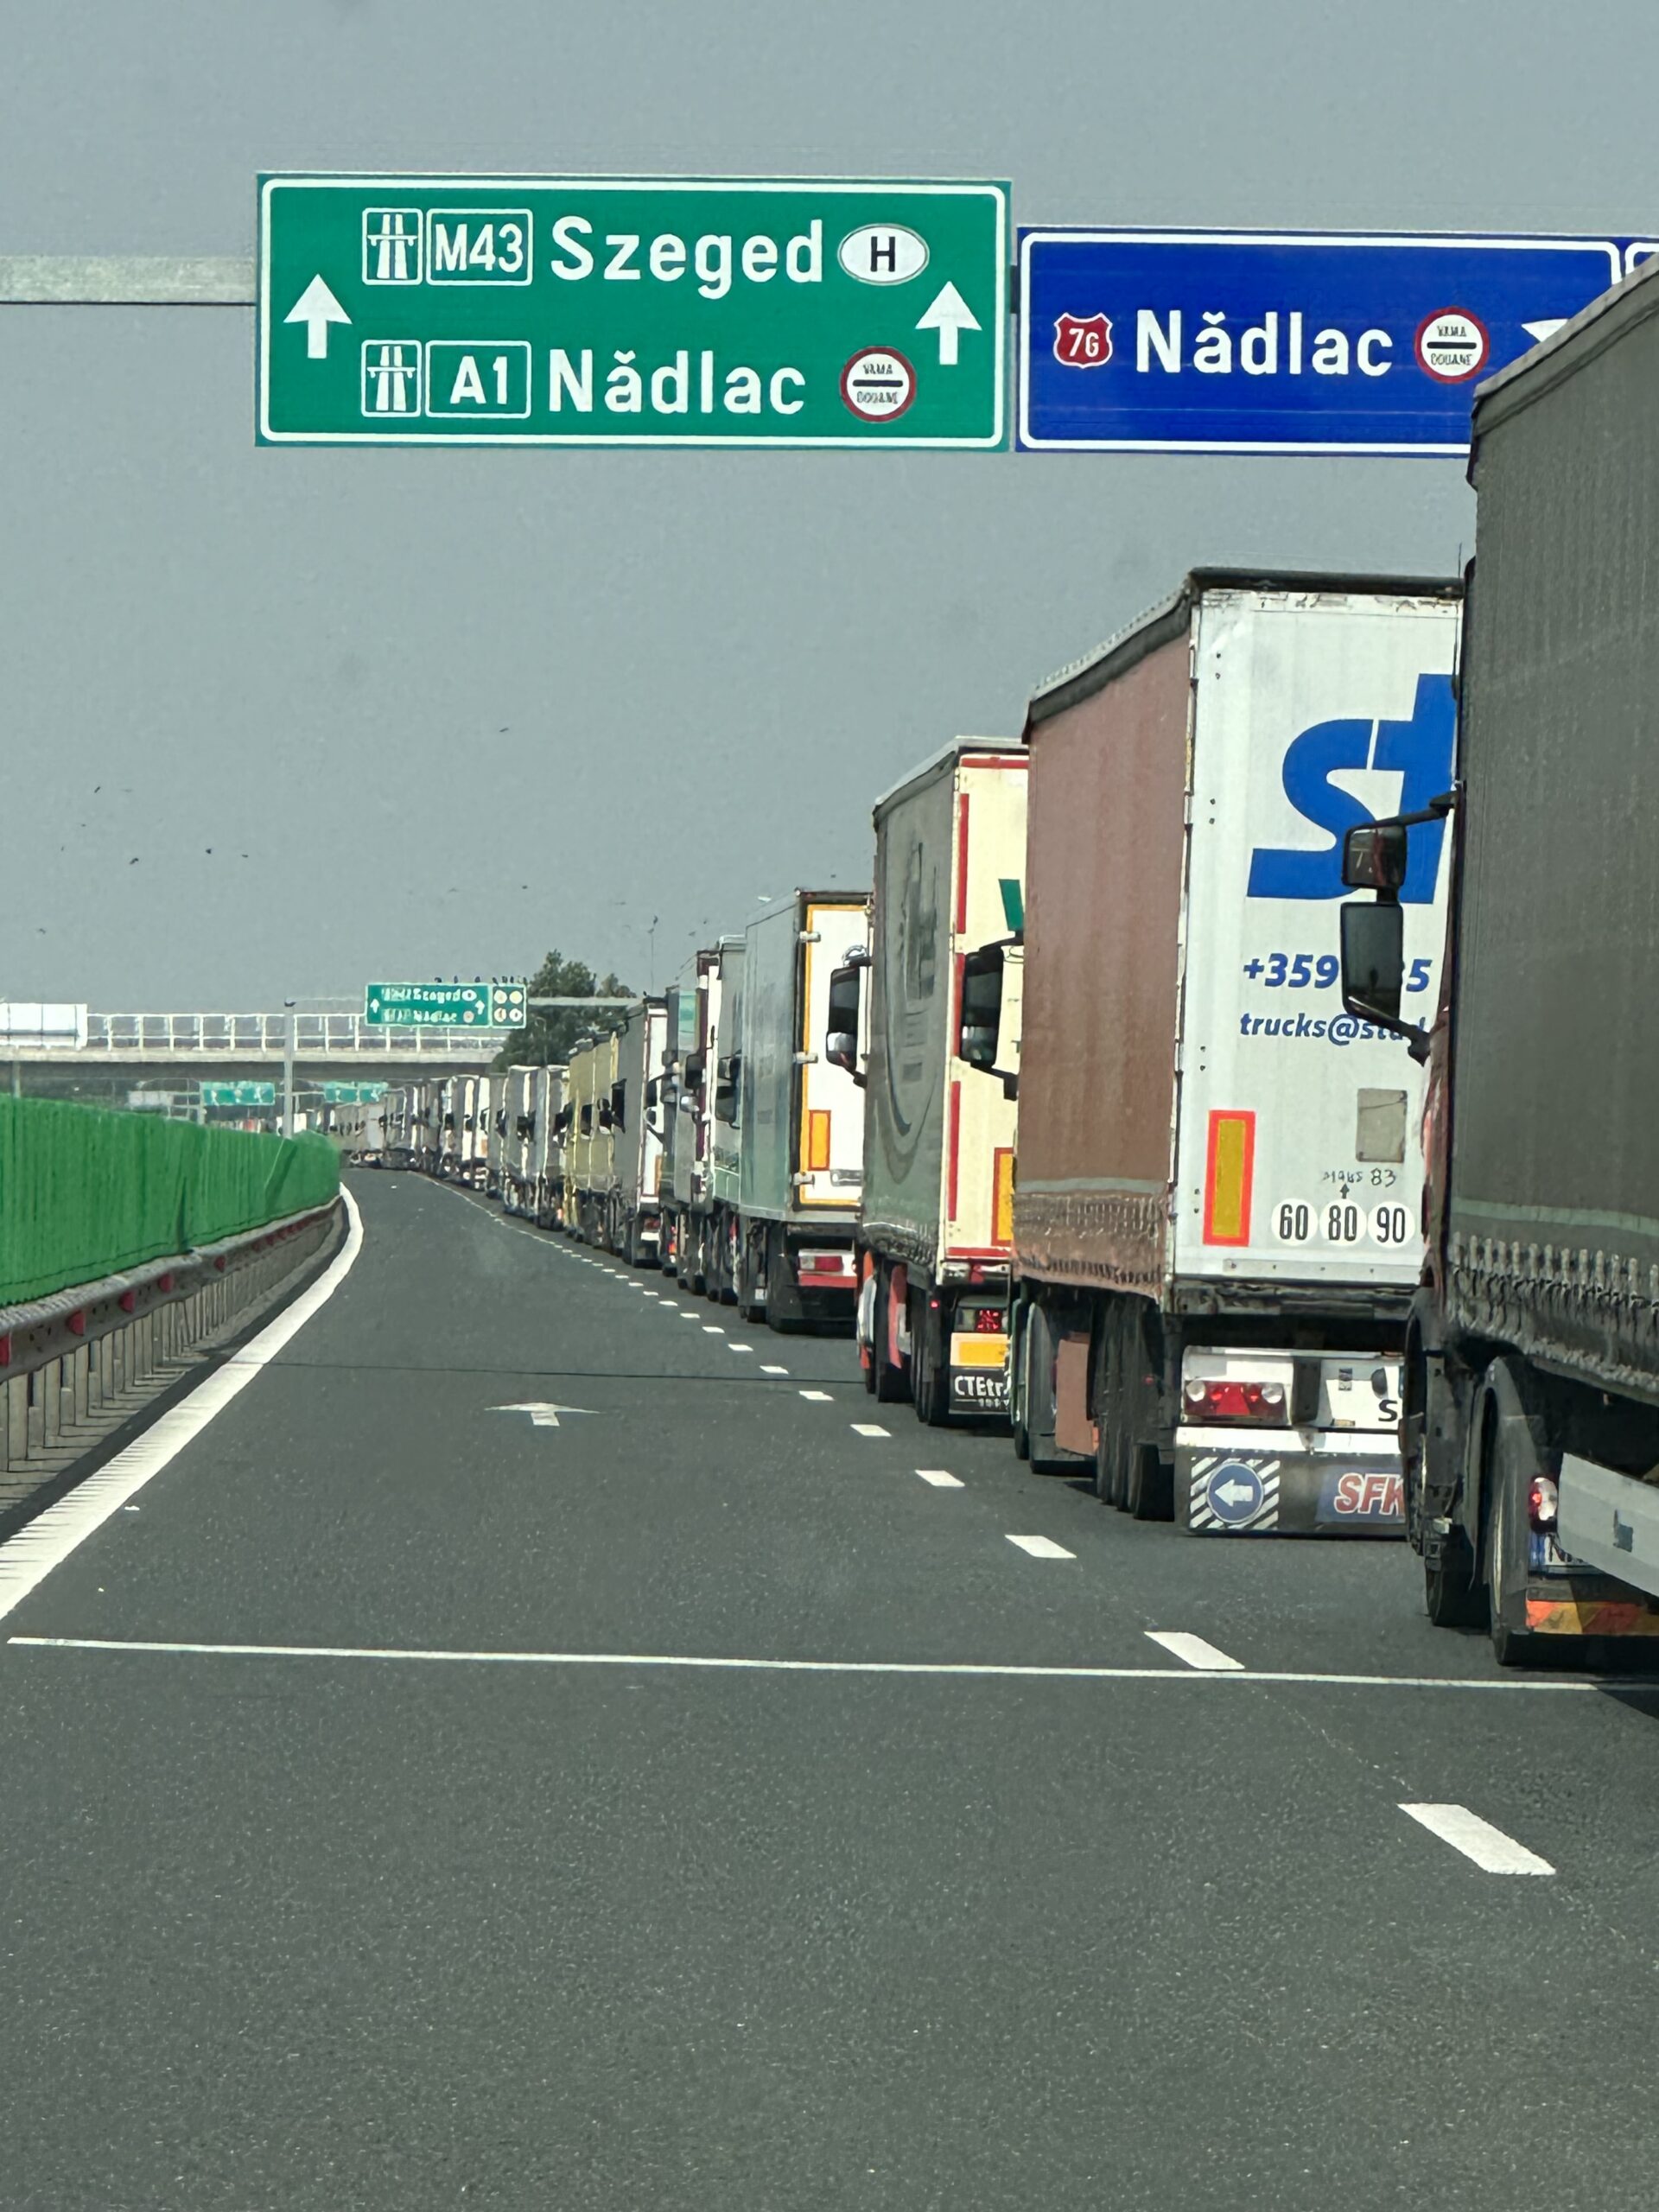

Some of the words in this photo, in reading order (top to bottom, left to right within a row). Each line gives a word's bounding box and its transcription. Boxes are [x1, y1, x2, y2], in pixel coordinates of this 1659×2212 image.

[435, 223, 524, 273] M43
[550, 215, 823, 300] Szeged
[870, 236, 895, 272] H
[1069, 328, 1099, 357] 7G
[1135, 309, 1393, 377] Nădlac
[450, 355, 507, 405] A1
[549, 348, 805, 415] Nădlac
[1370, 1168, 1396, 1188] 83
[1279, 1204, 1309, 1241] 60
[1328, 1205, 1357, 1242] 80
[1376, 1206, 1406, 1243] 90
